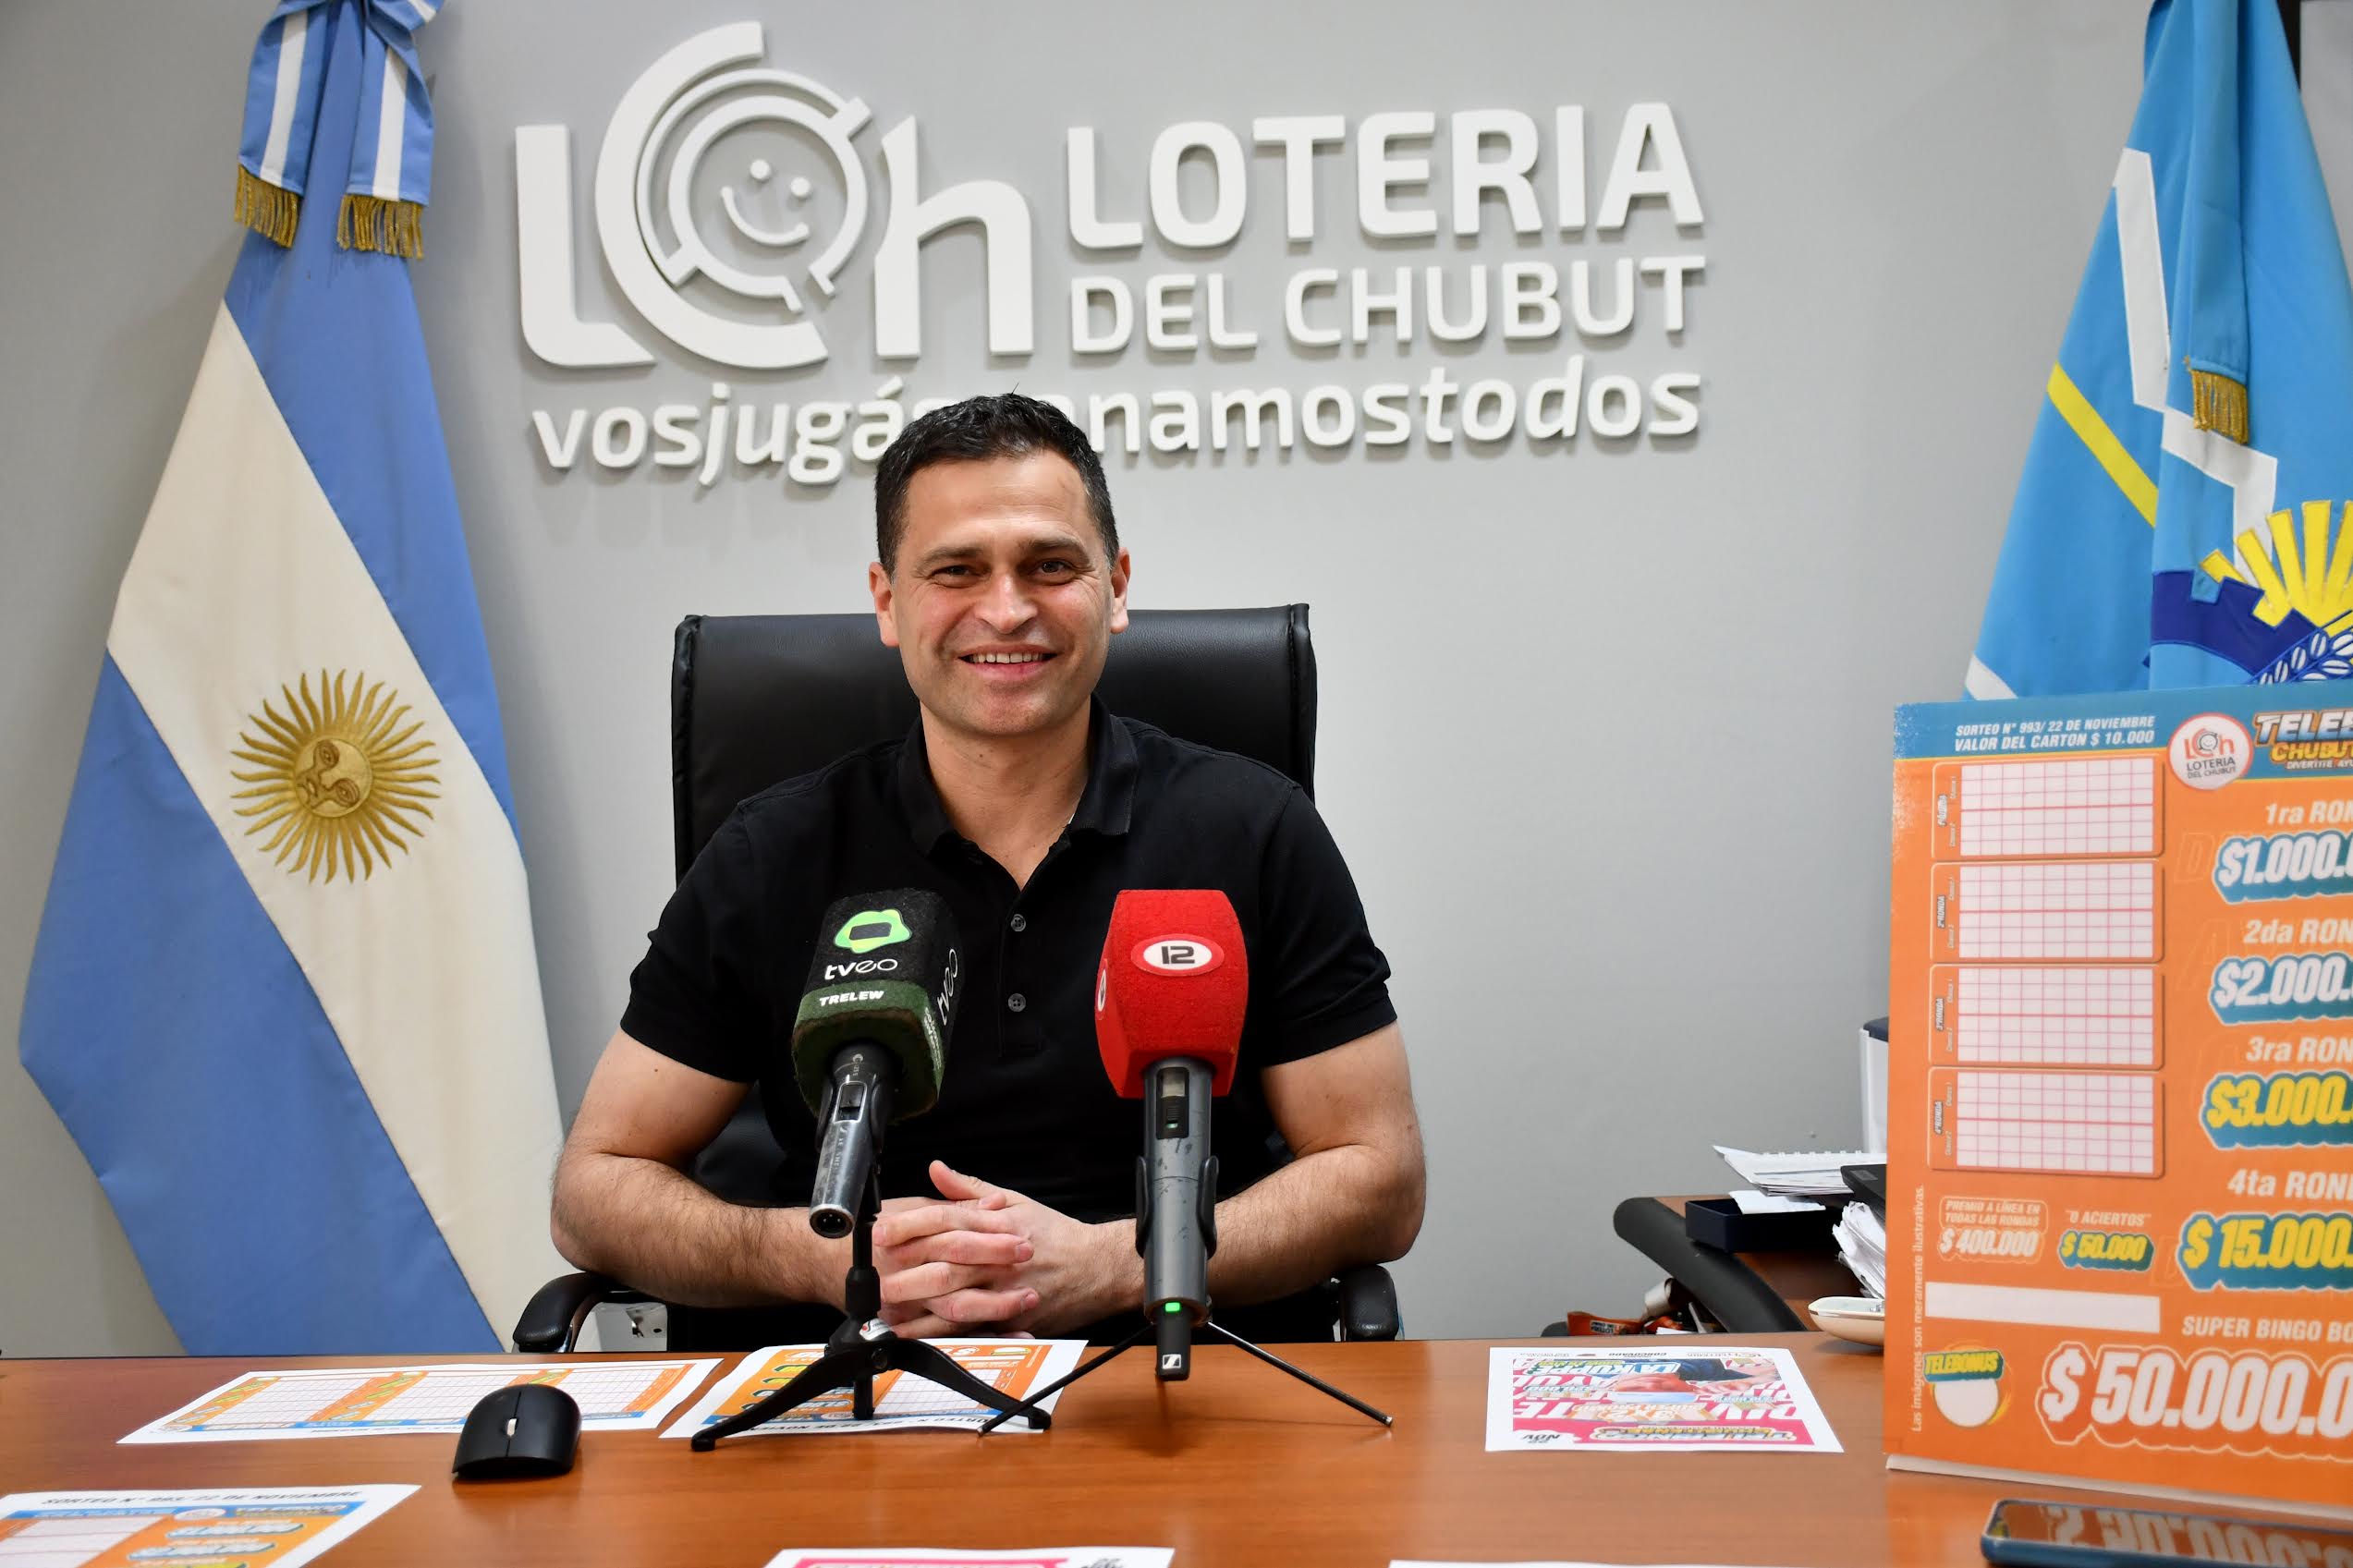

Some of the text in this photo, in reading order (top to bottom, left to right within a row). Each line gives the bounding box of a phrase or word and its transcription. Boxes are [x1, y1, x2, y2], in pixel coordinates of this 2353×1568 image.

[1067, 103, 1703, 249] LOTERIA
[1071, 255, 1705, 353] DEL CHUBUT
[1956, 723, 1999, 737] SORTEO
[2048, 720, 2063, 733] 22
[2066, 719, 2081, 731] DE
[2084, 715, 2156, 730] NOVIEMBRE
[1955, 730, 2155, 752] VALOR DEL CARTON $ 10.000
[2187, 757, 2237, 772] LOTERIA
[2187, 770, 2202, 779] DEL
[2265, 803, 2305, 825] 1ra
[2218, 833, 2353, 888] $1.000.
[2243, 918, 2294, 944] 2da
[1161, 945, 1196, 965] 12
[824, 958, 898, 980] tveo
[819, 990, 884, 1006] TRELEW
[2246, 1035, 2292, 1062] 3ra
[2227, 1168, 2276, 1197] 4ta
[1945, 1200, 1984, 1213] PREMIO
[1986, 1202, 1994, 1213] A
[2026, 1203, 2041, 1214] EN
[1945, 1212, 2040, 1227] TODAS LAS RONDAS
[1941, 1227, 2039, 1257] $ 400.000
[2060, 1232, 2148, 1262] $ 50.000
[2182, 1218, 2213, 1270] $
[1912, 1255, 1923, 1324] meramente
[1913, 1326, 1923, 1348] son
[2181, 1315, 2250, 1339] SUPER
[2255, 1318, 2323, 1342] BINGO
[1910, 1351, 1925, 1409] imágenes
[2042, 1347, 2087, 1422] $
[1909, 1411, 1922, 1433] Las
